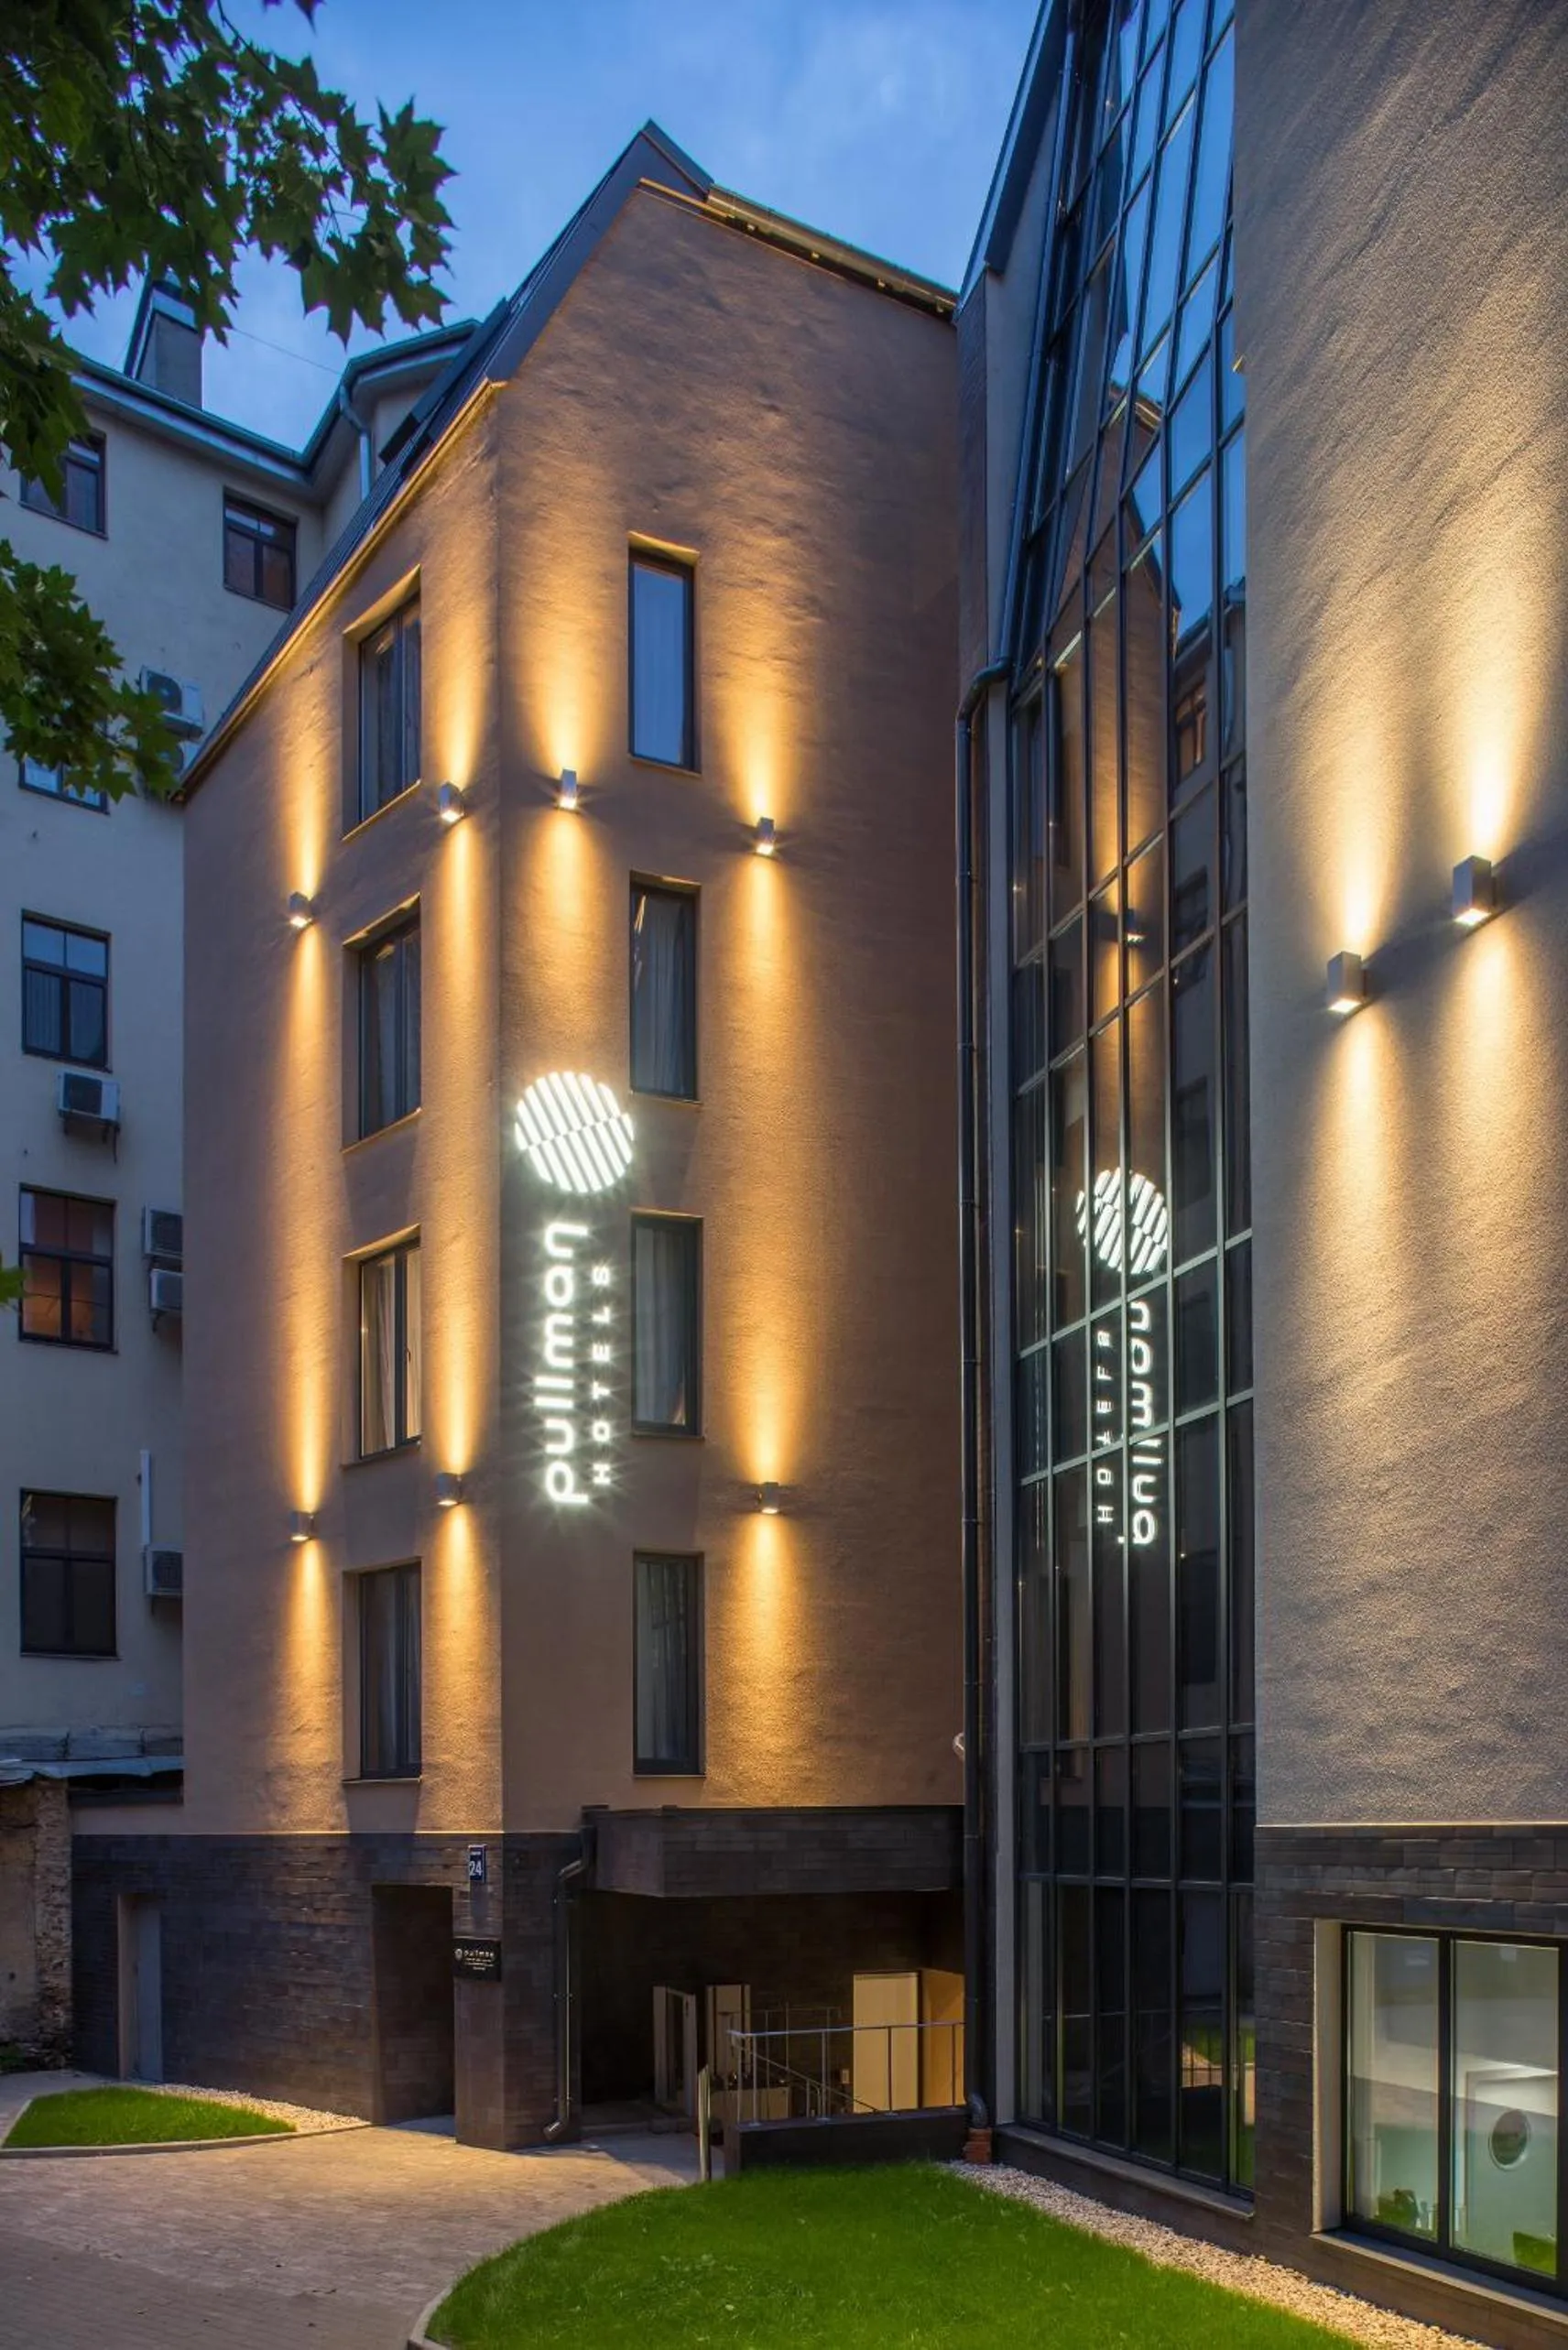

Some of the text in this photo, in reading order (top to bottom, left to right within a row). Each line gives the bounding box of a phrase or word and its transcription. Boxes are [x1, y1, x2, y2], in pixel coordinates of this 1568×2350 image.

[534, 1221, 589, 1505] pullman
[592, 1266, 612, 1485] HOTELS
[469, 1860, 483, 1877] 24
